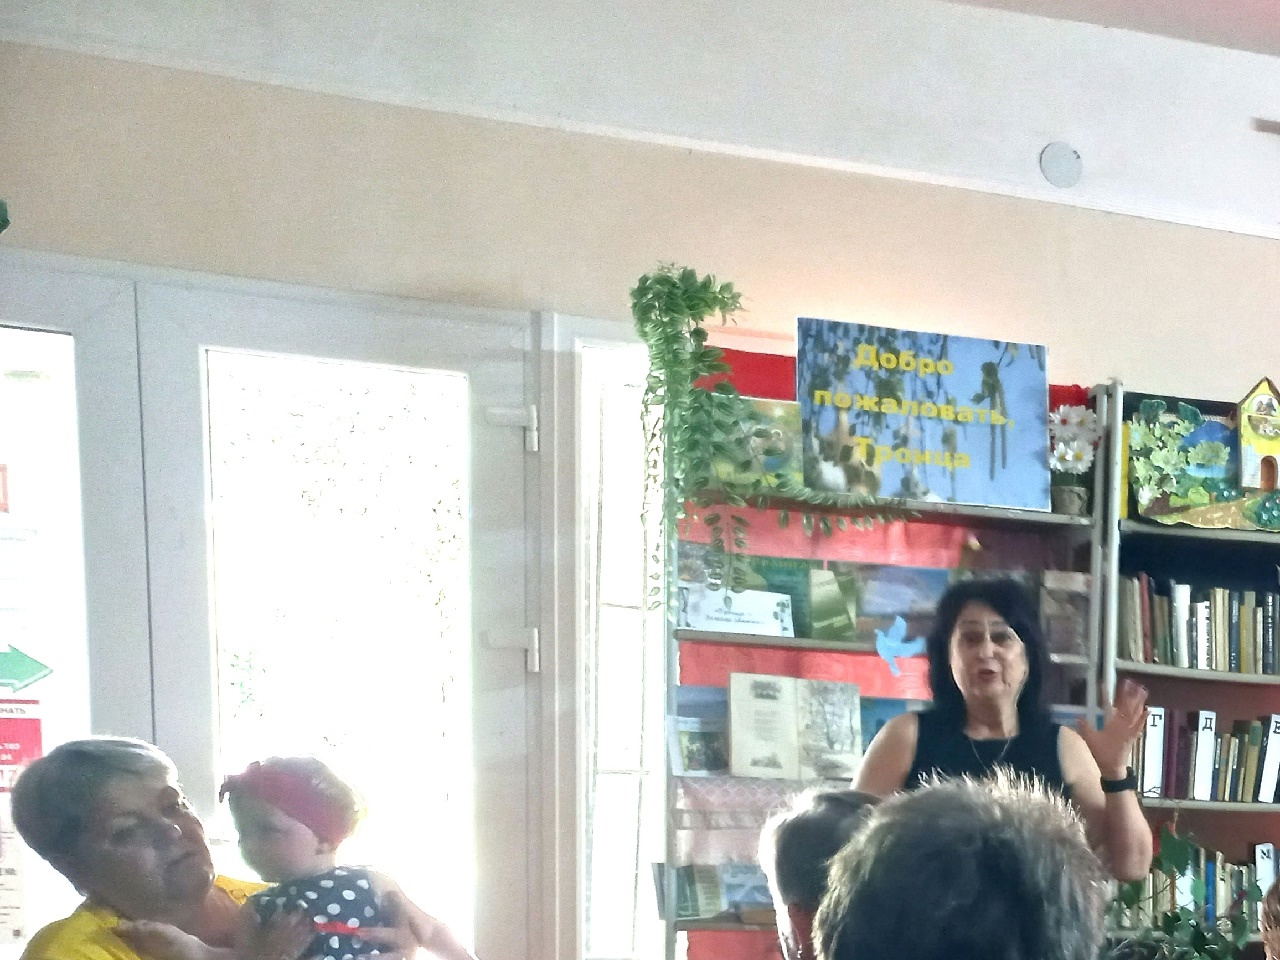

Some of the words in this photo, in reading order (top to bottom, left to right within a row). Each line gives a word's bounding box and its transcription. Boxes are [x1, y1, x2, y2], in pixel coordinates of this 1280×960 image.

[853, 343, 955, 378] Добро
[813, 389, 1015, 431] пожаловать,
[853, 435, 972, 473] Троица
[1150, 713, 1163, 727] Г
[1202, 717, 1214, 732] Д
